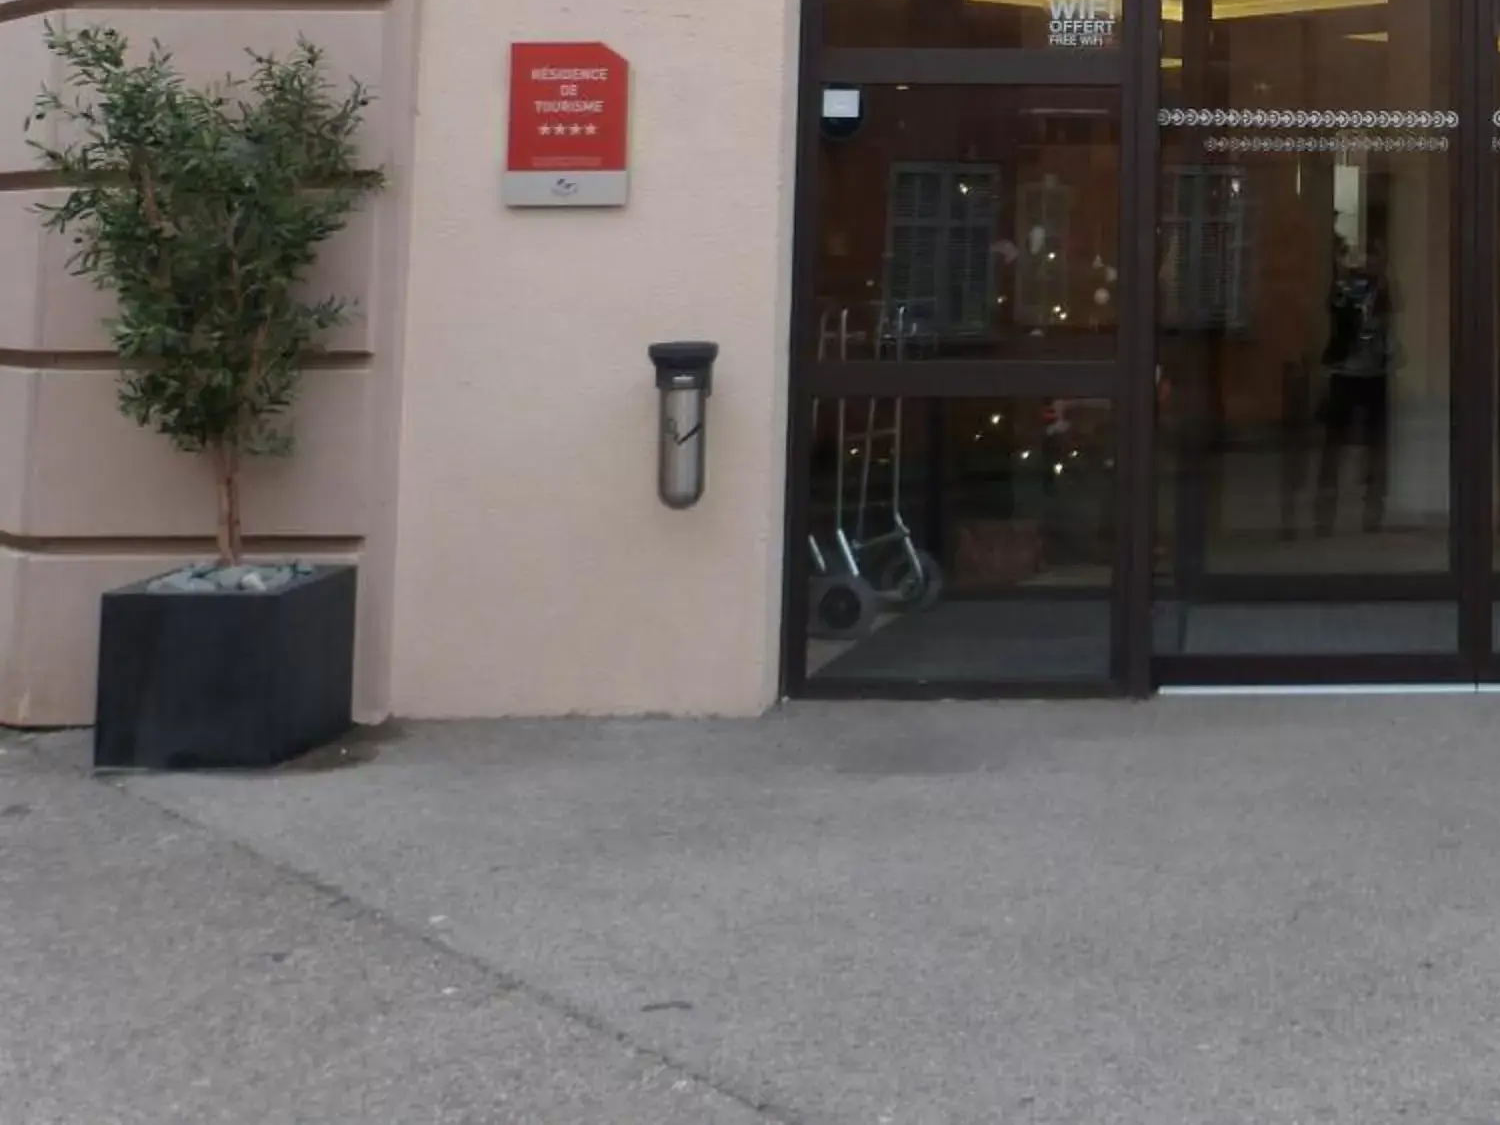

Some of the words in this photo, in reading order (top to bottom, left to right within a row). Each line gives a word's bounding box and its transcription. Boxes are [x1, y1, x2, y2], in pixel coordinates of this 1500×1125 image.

[1049, 20, 1115, 34] OFFERT
[1049, 34, 1077, 46] FREE
[560, 85, 577, 96] DE
[534, 100, 604, 114] TOURISME
